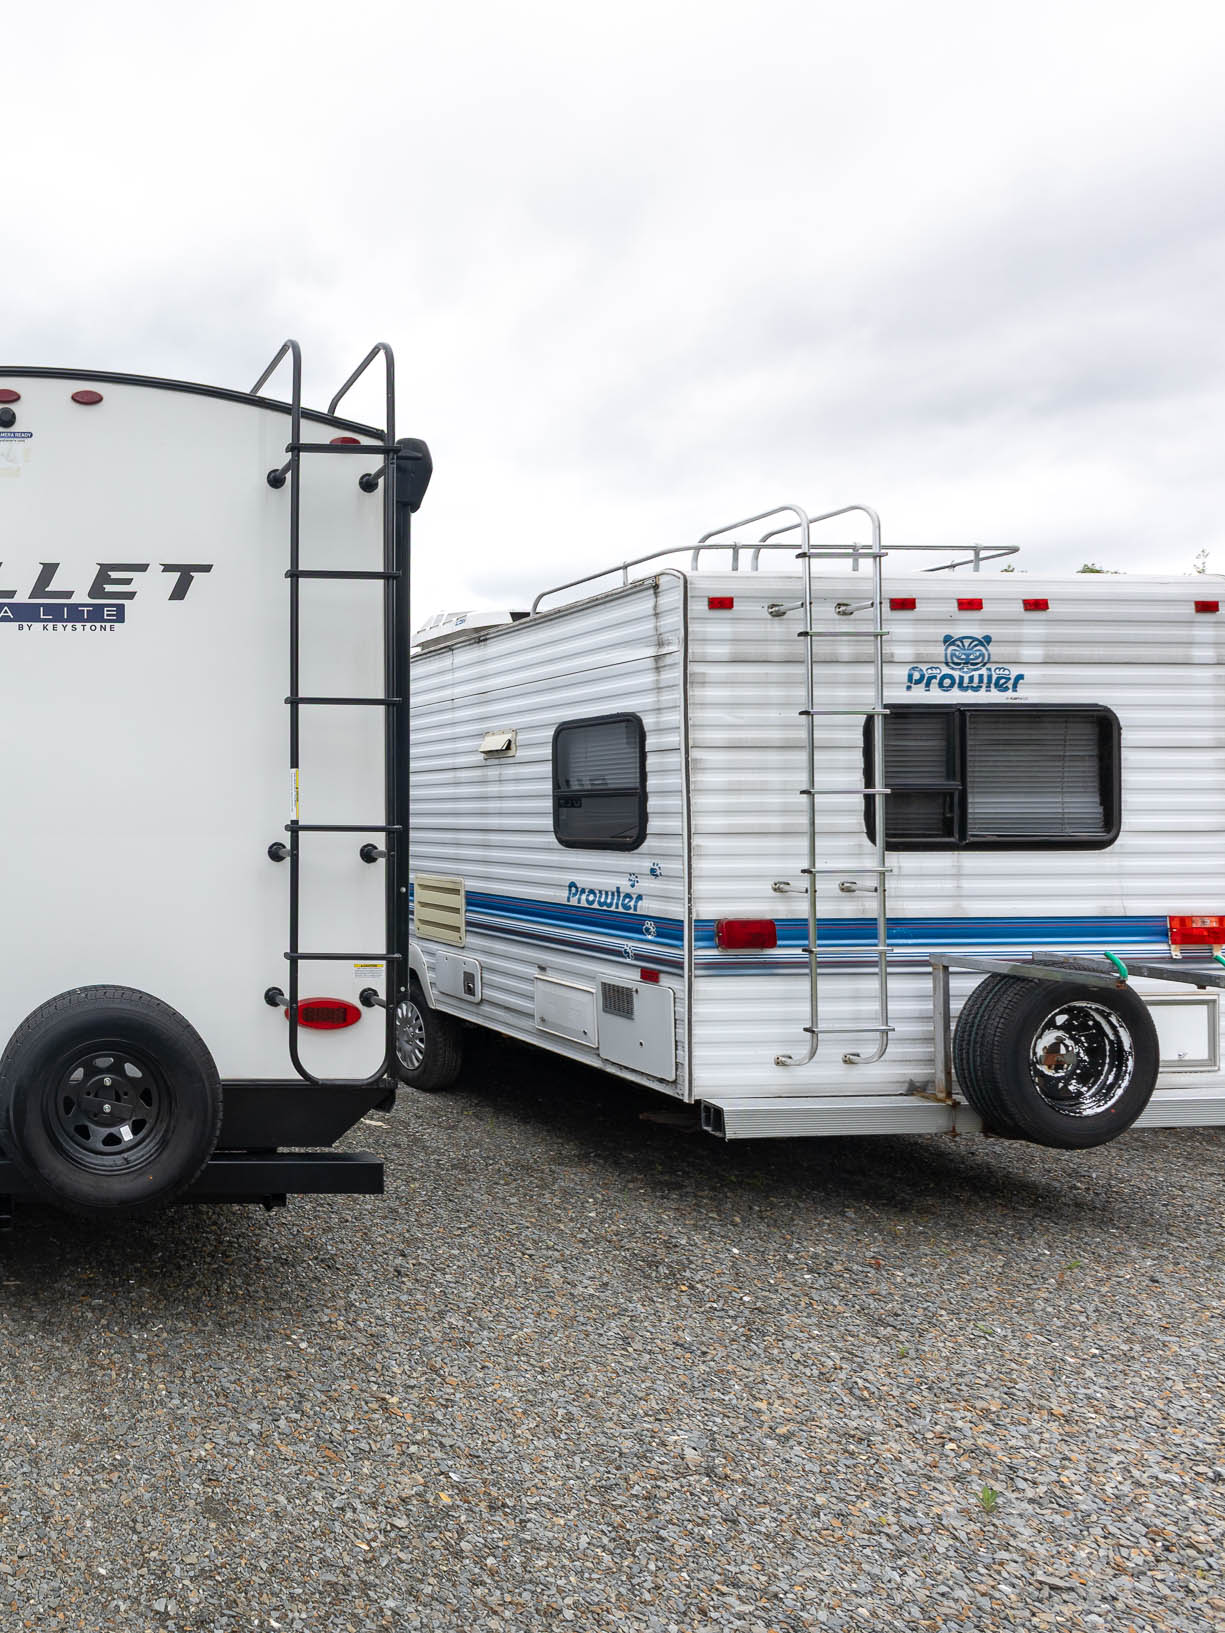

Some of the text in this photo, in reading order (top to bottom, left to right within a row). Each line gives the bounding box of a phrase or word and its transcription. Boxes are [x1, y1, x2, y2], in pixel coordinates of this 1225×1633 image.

[39, 605, 118, 620] LITE
[17, 623, 117, 633] BY KEYSTONE
[905, 665, 1025, 693] Prowler
[566, 881, 643, 912] Prowler
